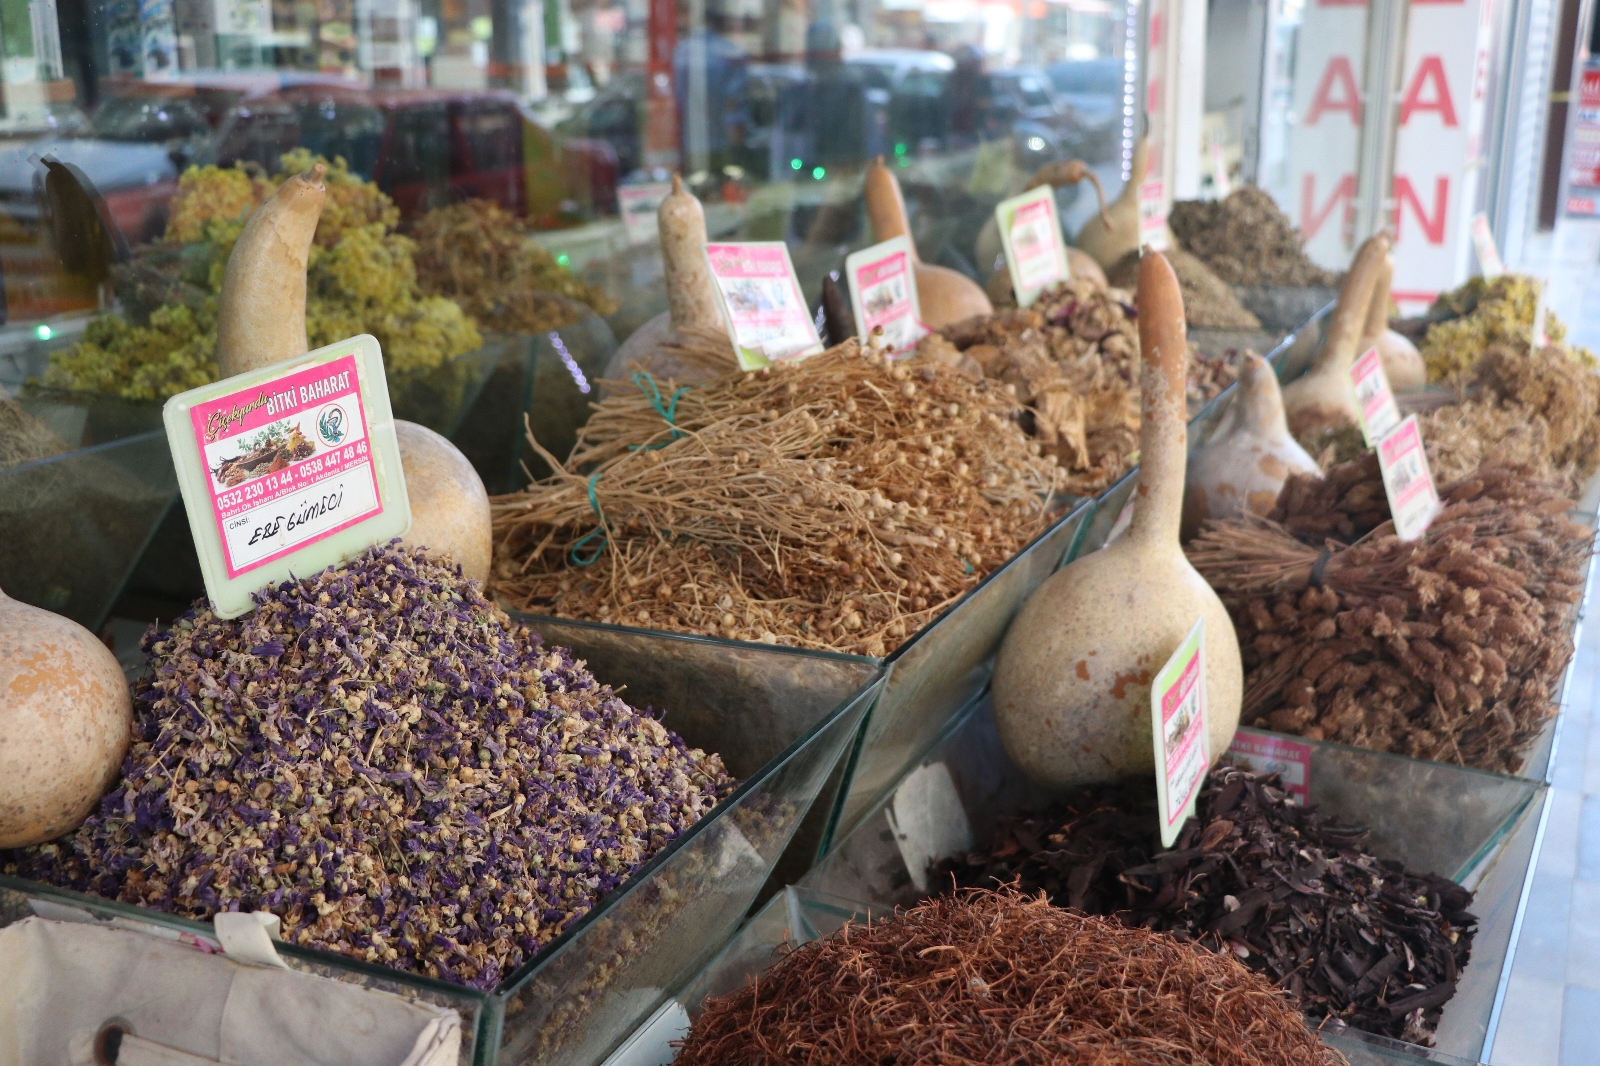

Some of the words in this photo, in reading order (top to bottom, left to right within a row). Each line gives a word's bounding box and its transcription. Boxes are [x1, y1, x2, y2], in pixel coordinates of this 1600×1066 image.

[266, 386, 298, 416] BİTKİ
[299, 371, 350, 404] BAHARAT
[217, 490, 244, 510] 0532
[244, 482, 264, 500] 230
[265, 476, 279, 491] 13
[280, 470, 293, 485] 44
[299, 459, 323, 478] 0538
[325, 451, 341, 468] 447
[343, 446, 355, 460] 48
[356, 441, 368, 455] 46
[275, 484, 297, 498] A/Blok
[315, 467, 340, 482] Akdeniz
